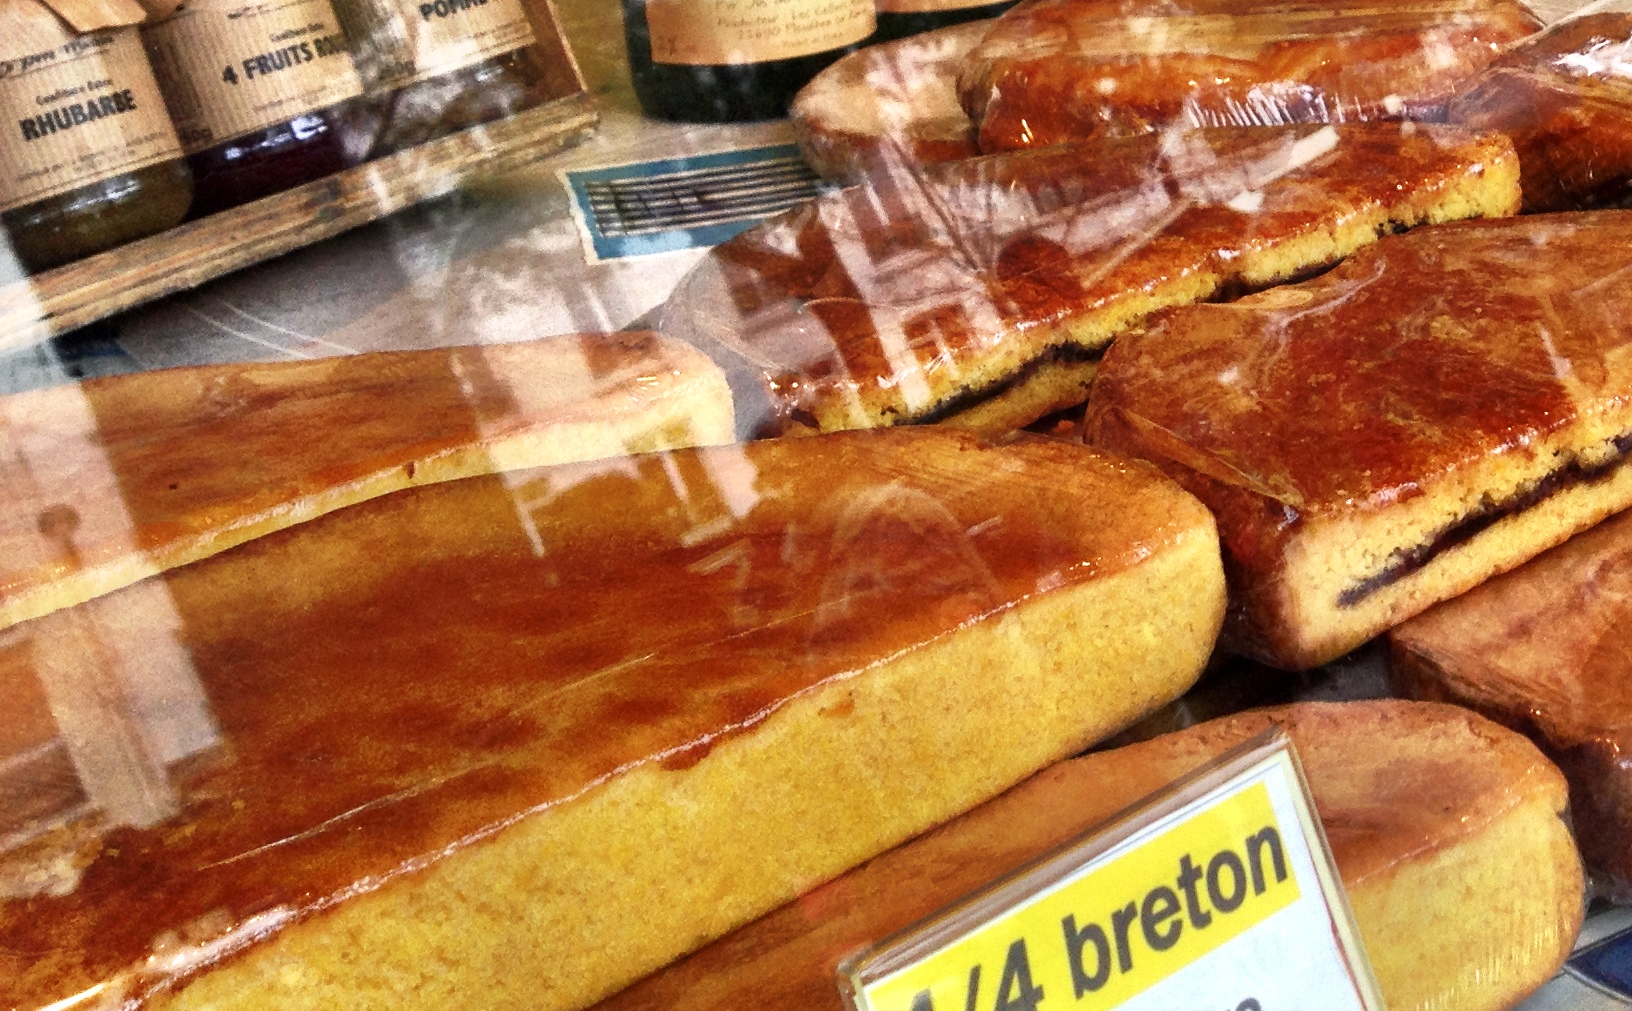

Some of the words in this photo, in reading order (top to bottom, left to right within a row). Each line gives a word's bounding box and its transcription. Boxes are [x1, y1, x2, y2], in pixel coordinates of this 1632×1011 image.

[222, 65, 239, 85] 4
[242, 42, 313, 80] FRUITS
[19, 89, 138, 140] RHUBARBE
[1060, 824, 1289, 1001] breton
